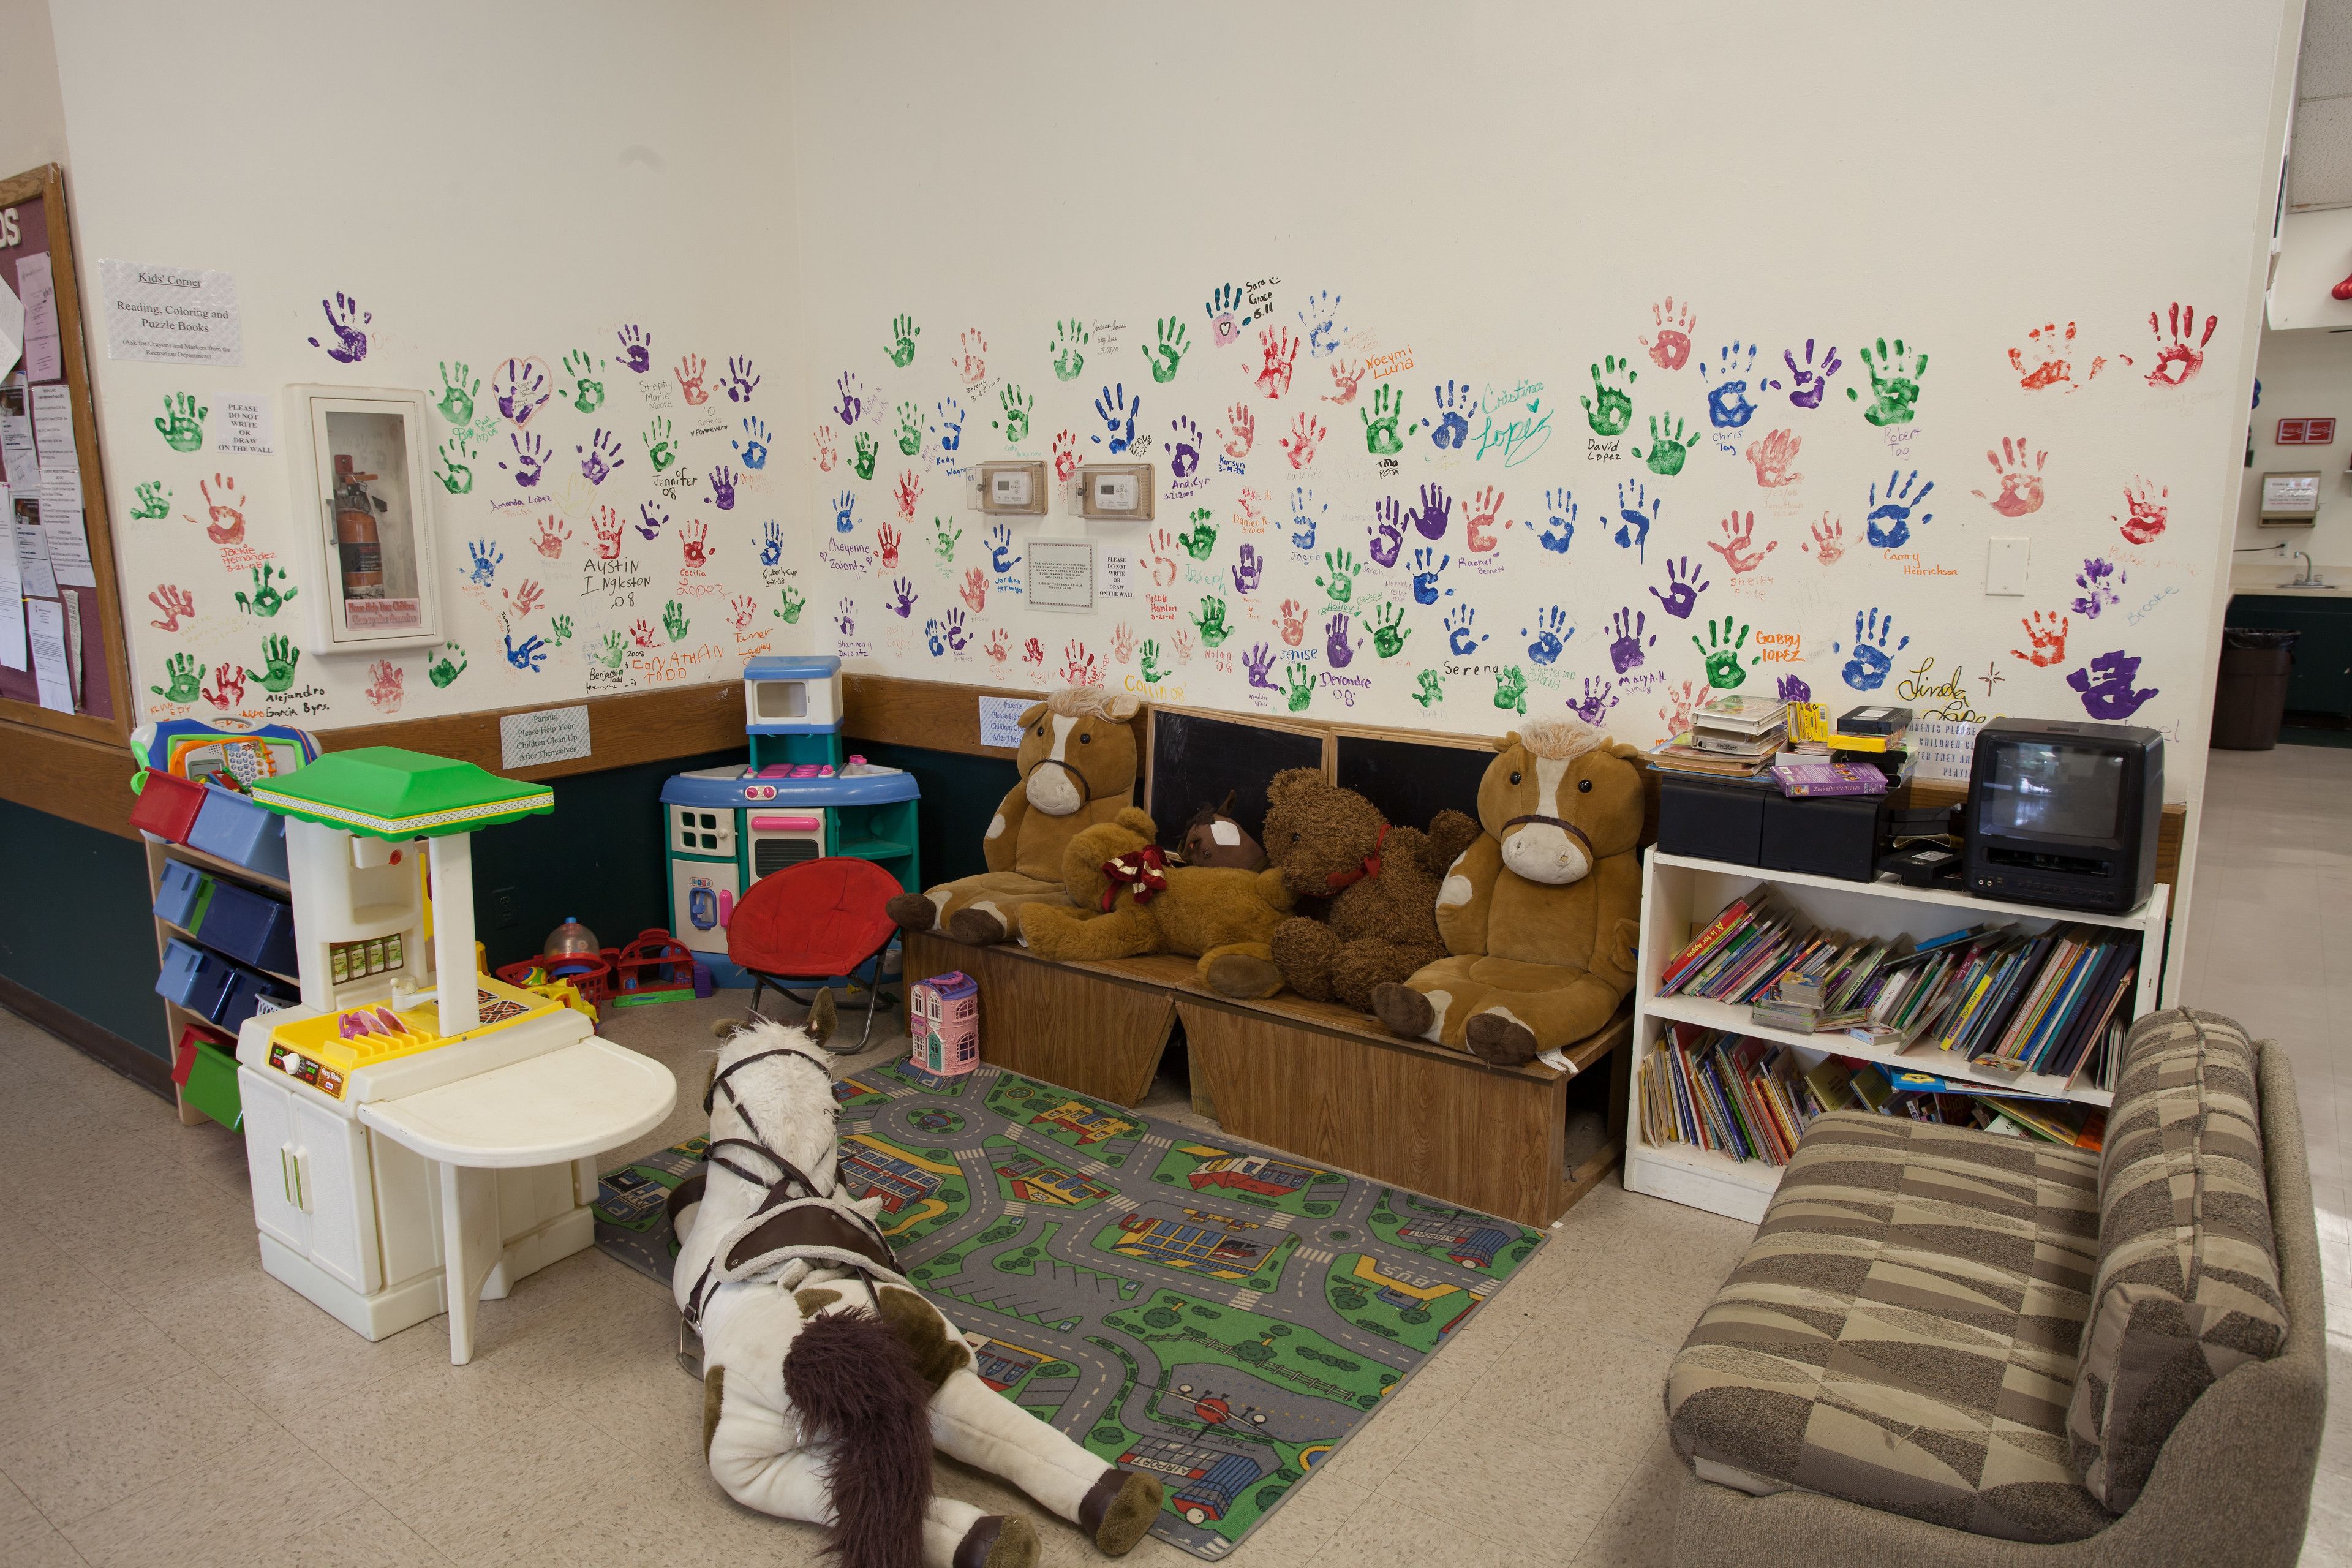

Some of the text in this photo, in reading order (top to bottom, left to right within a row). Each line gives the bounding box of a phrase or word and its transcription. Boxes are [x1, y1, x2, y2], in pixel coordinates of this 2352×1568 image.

[138, 272, 202, 287] Kids' Corner
[1246, 279, 1267, 293] Sara
[1248, 291, 1273, 306] Grace
[165, 306, 208, 319] Coloring
[211, 311, 228, 320] and
[141, 318, 209, 333] Puzzle Books
[178, 351, 211, 360] Department)
[646, 393, 669, 402] Marie
[1713, 429, 1744, 442] Chris
[1883, 426, 1922, 444] Robert
[1588, 439, 1621, 453] David
[1888, 443, 1910, 460] Tag
[937, 456, 955, 467] Kady
[1219, 454, 1246, 469] Karsyn
[1588, 451, 1622, 462] Lopez
[662, 488, 677, 500] 08
[490, 499, 526, 513] Amanda
[528, 495, 553, 504] Lopez
[1233, 513, 1260, 527] Daniel
[220, 544, 255, 558] Jackie
[829, 537, 870, 554] Cheyenne
[222, 552, 277, 566] Hernandez
[1291, 551, 1321, 560] Jacob
[226, 561, 263, 572] 3-21-08
[1458, 558, 1492, 568] Rachel
[680, 568, 706, 578] Cecilia
[677, 578, 733, 603] Lopez
[348, 601, 415, 614] Please Help Your Children
[1327, 601, 1354, 612] Hailey
[2126, 585, 2180, 627] Brooke
[1205, 649, 1232, 660] Nolan
[589, 668, 624, 682] Benjamin
[1444, 660, 1500, 676] Serena
[1898, 657, 1970, 707] Linda
[265, 684, 325, 704] Alejandro
[533, 714, 557, 723] Parents
[992, 711, 1008, 720] Please
[518, 729, 539, 737] Please
[541, 726, 556, 734] Help
[1945, 725, 1977, 736] PLEASE
[516, 741, 545, 750] Children
[546, 736, 566, 745] Clean
[1918, 737, 1961, 748] CHILDREN
[519, 746, 577, 761] After Themselves
[1934, 752, 1956, 763] THEY
[1702, 934, 1713, 945] for
[1686, 943, 1703, 959] Apple
[2006, 986, 2020, 1004] STARS
[1410, 1231, 1456, 1242] AIRPORT
[1382, 1265, 1434, 1287] BUS
[1133, 1457, 1190, 1477] AIRPORT
